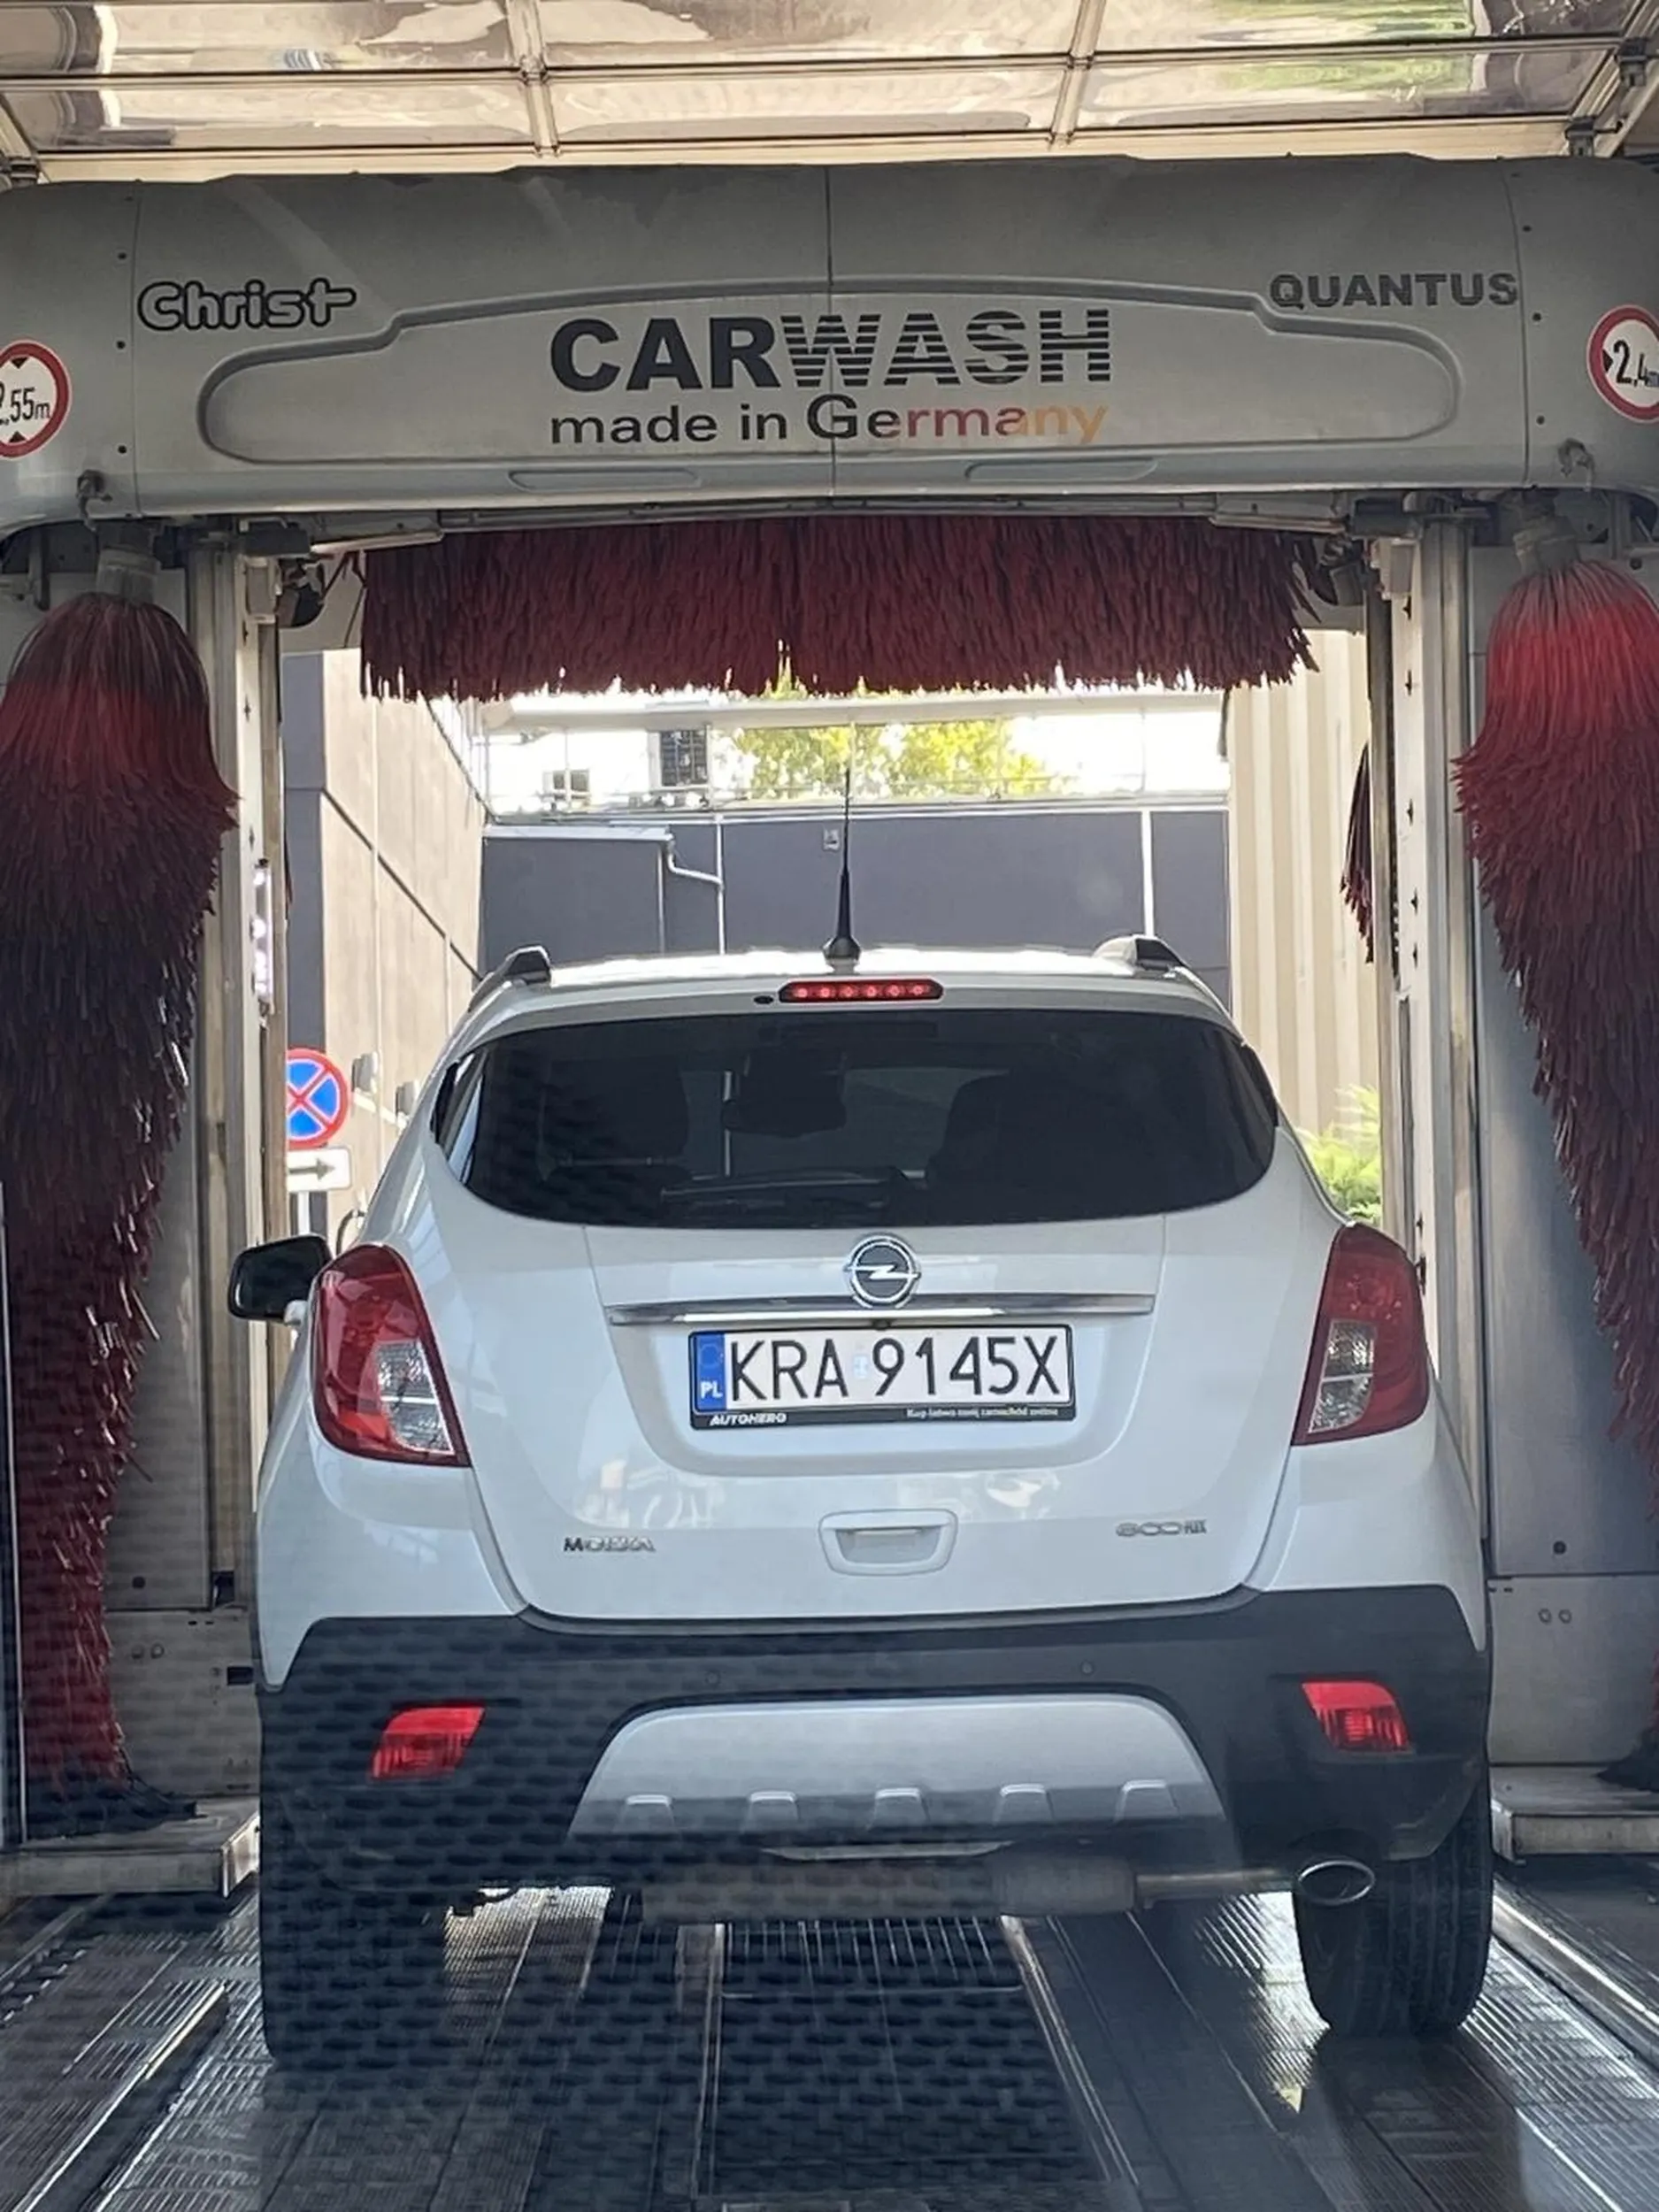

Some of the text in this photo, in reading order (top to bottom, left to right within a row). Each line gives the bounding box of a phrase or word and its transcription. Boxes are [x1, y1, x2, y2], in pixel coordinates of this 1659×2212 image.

[137, 277, 357, 332] Christ
[1270, 273, 1519, 311] QUANTUS
[550, 309, 1111, 392] CARWASH
[550, 393, 1110, 444] made in Germany
[701, 1380, 724, 1399] PL
[730, 1334, 1061, 1402] KRA 9145X
